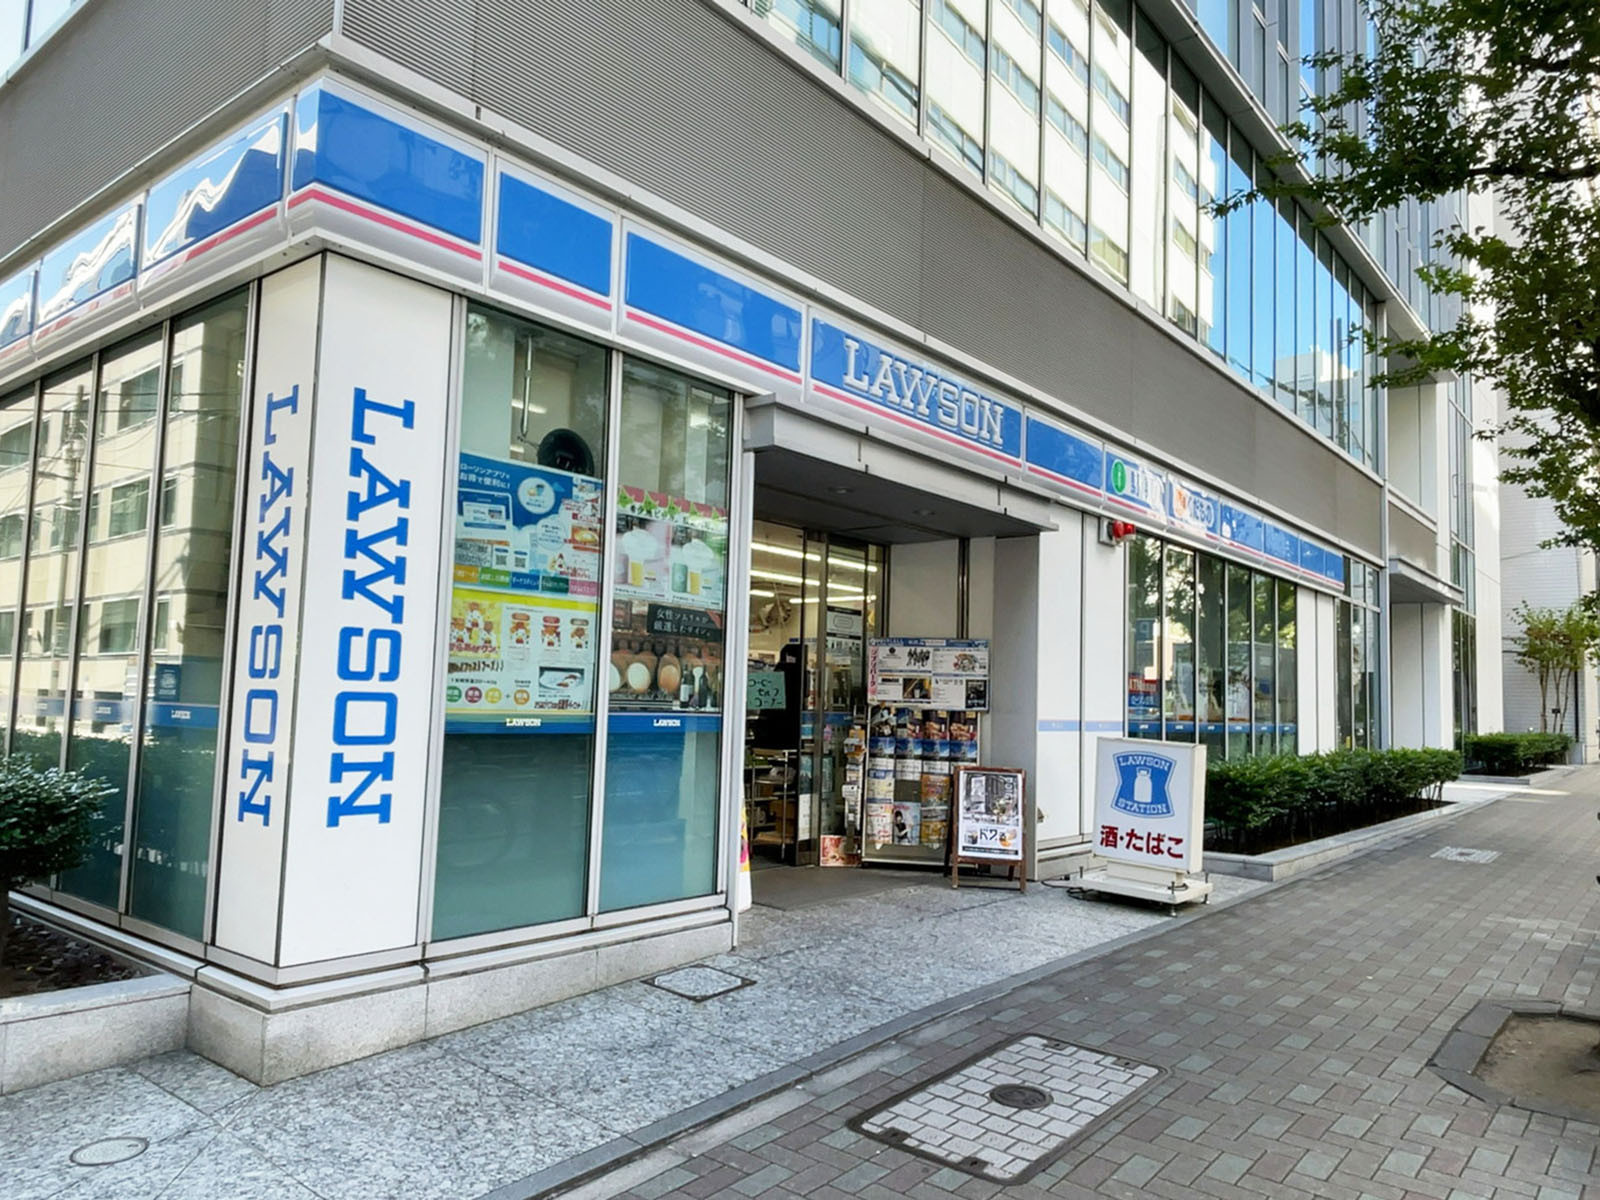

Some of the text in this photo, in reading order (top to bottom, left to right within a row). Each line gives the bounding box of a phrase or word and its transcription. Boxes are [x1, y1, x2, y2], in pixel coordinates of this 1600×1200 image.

[844, 337, 1004, 445] LAWSON
[237, 384, 300, 828] LAWSON
[326, 387, 415, 828] LAWSON
[1119, 755, 1171, 772] LAWSON
[1100, 824, 1184, 859] 酒・たばこ
[1117, 798, 1168, 814] STATION
